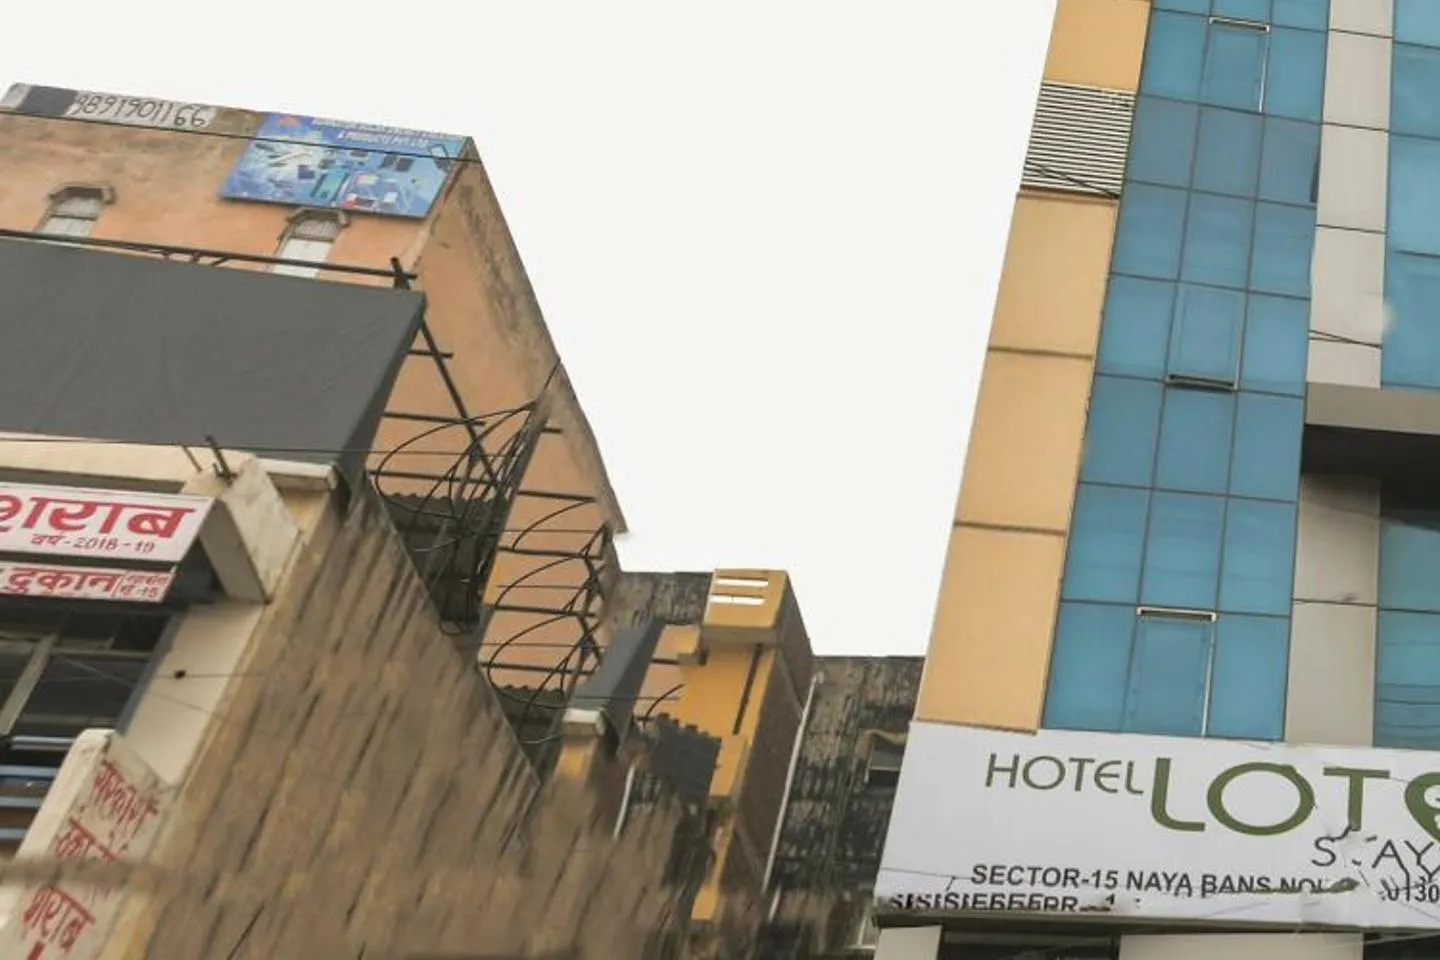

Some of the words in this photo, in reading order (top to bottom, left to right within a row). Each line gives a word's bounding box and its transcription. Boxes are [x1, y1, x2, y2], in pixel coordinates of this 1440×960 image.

[985, 752, 1144, 795] HOTEL
[970, 863, 1119, 890] SECTOR-15
[1126, 870, 1193, 897] NAYA
